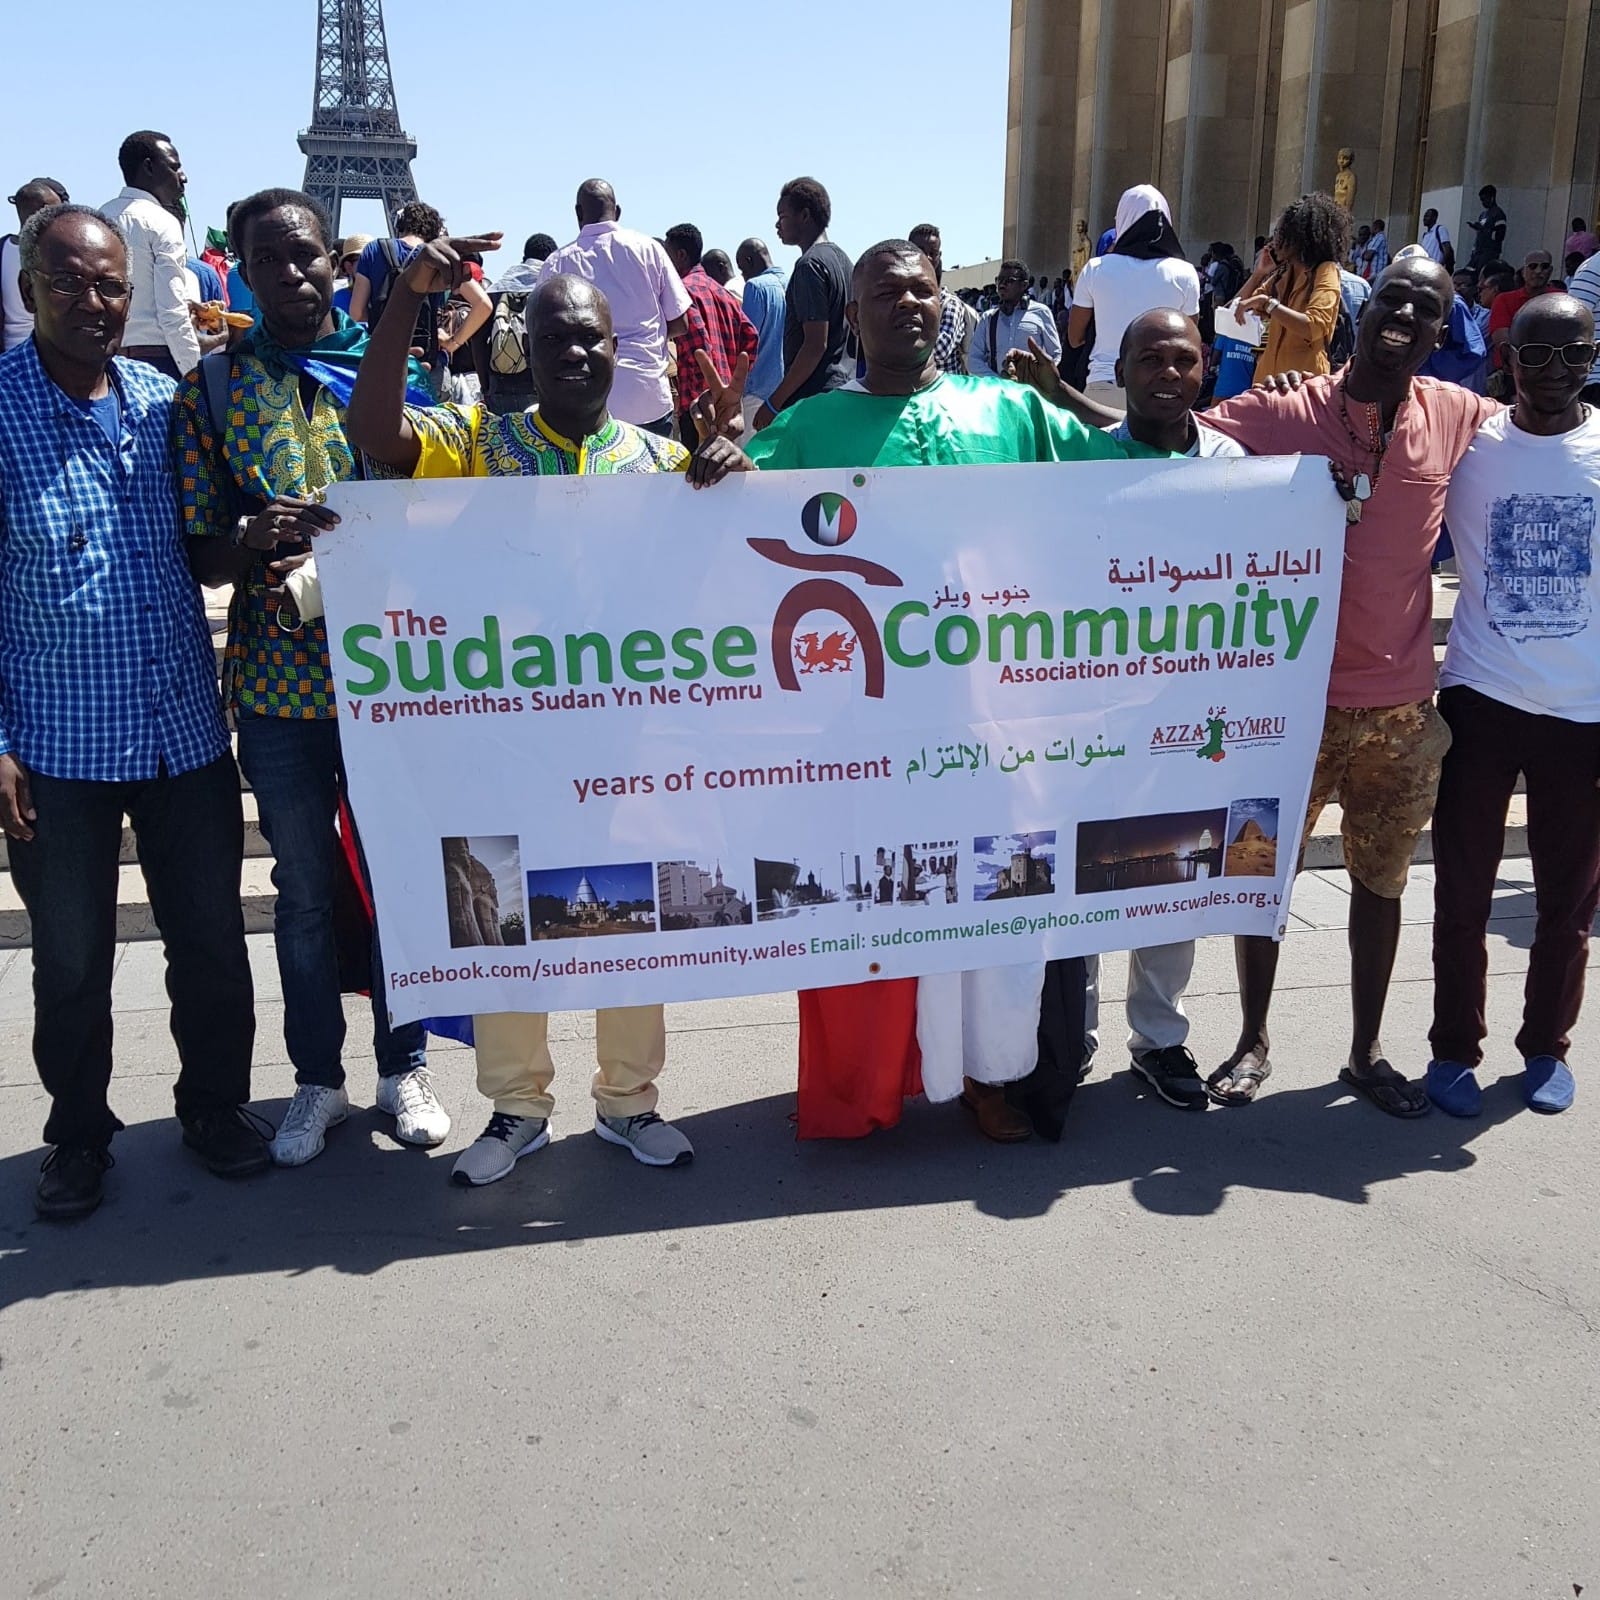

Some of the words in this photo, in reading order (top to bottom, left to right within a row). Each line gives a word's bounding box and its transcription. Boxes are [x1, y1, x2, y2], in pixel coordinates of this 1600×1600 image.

[1513, 523, 1560, 541] FAITH
[1109, 553, 1232, 593] السودانية
[1246, 548, 1320, 585] الجالية
[1516, 549, 1532, 568] IS
[1538, 549, 1561, 567] MY
[933, 585, 970, 609] ويلز
[982, 585, 1030, 606] جنوب
[1503, 576, 1577, 594] RELIGION
[385, 609, 447, 636] The
[342, 614, 758, 696] Sudanese
[884, 582, 1320, 668] Community
[1000, 660, 1118, 683] Association
[1126, 656, 1147, 676] of
[1152, 653, 1209, 674] South
[1217, 649, 1274, 669] Wales
[348, 701, 363, 720] Y
[371, 692, 523, 723] gymderithas
[532, 689, 605, 711] Sudan
[612, 687, 642, 706] Yn
[650, 685, 681, 704] Ne
[688, 683, 761, 706] Cymru
[1150, 723, 1205, 744] AZZA
[1224, 716, 1286, 738] CYMRU
[1001, 745, 1035, 773] من
[1045, 735, 1125, 767] سنوات
[573, 775, 654, 803] years
[665, 765, 694, 791] of
[704, 756, 891, 789] commitment
[390, 940, 807, 990] Facebook.com/sudanesecommunity.wales
[811, 932, 866, 954] Email:
[871, 906, 1120, 948] sudcommwales@yahoo.com
